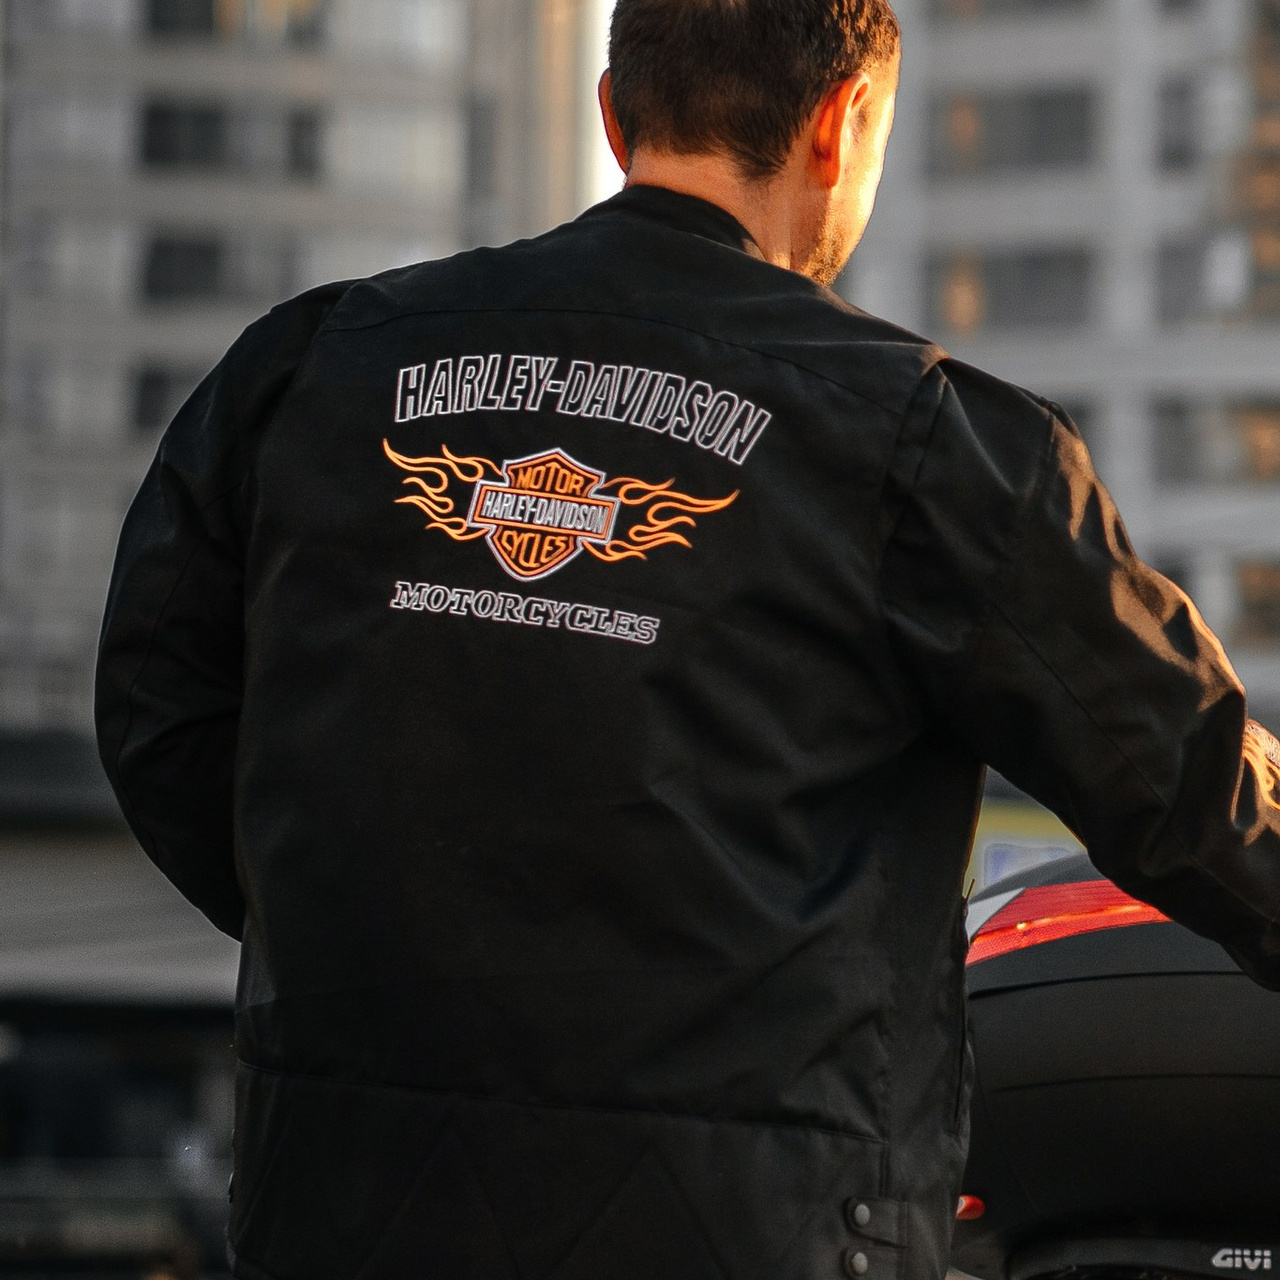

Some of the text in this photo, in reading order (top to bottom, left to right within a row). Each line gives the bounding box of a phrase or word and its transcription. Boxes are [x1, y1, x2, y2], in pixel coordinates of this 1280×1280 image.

[394, 353, 772, 466] HARLEY-DAVIDSON
[514, 461, 588, 496] MOTOR
[480, 491, 611, 535] HARLEY-DAVIDSON
[500, 529, 571, 569] CYCLES
[389, 581, 661, 645] MOTORCYCLES
[1211, 1247, 1272, 1270] GIVI
